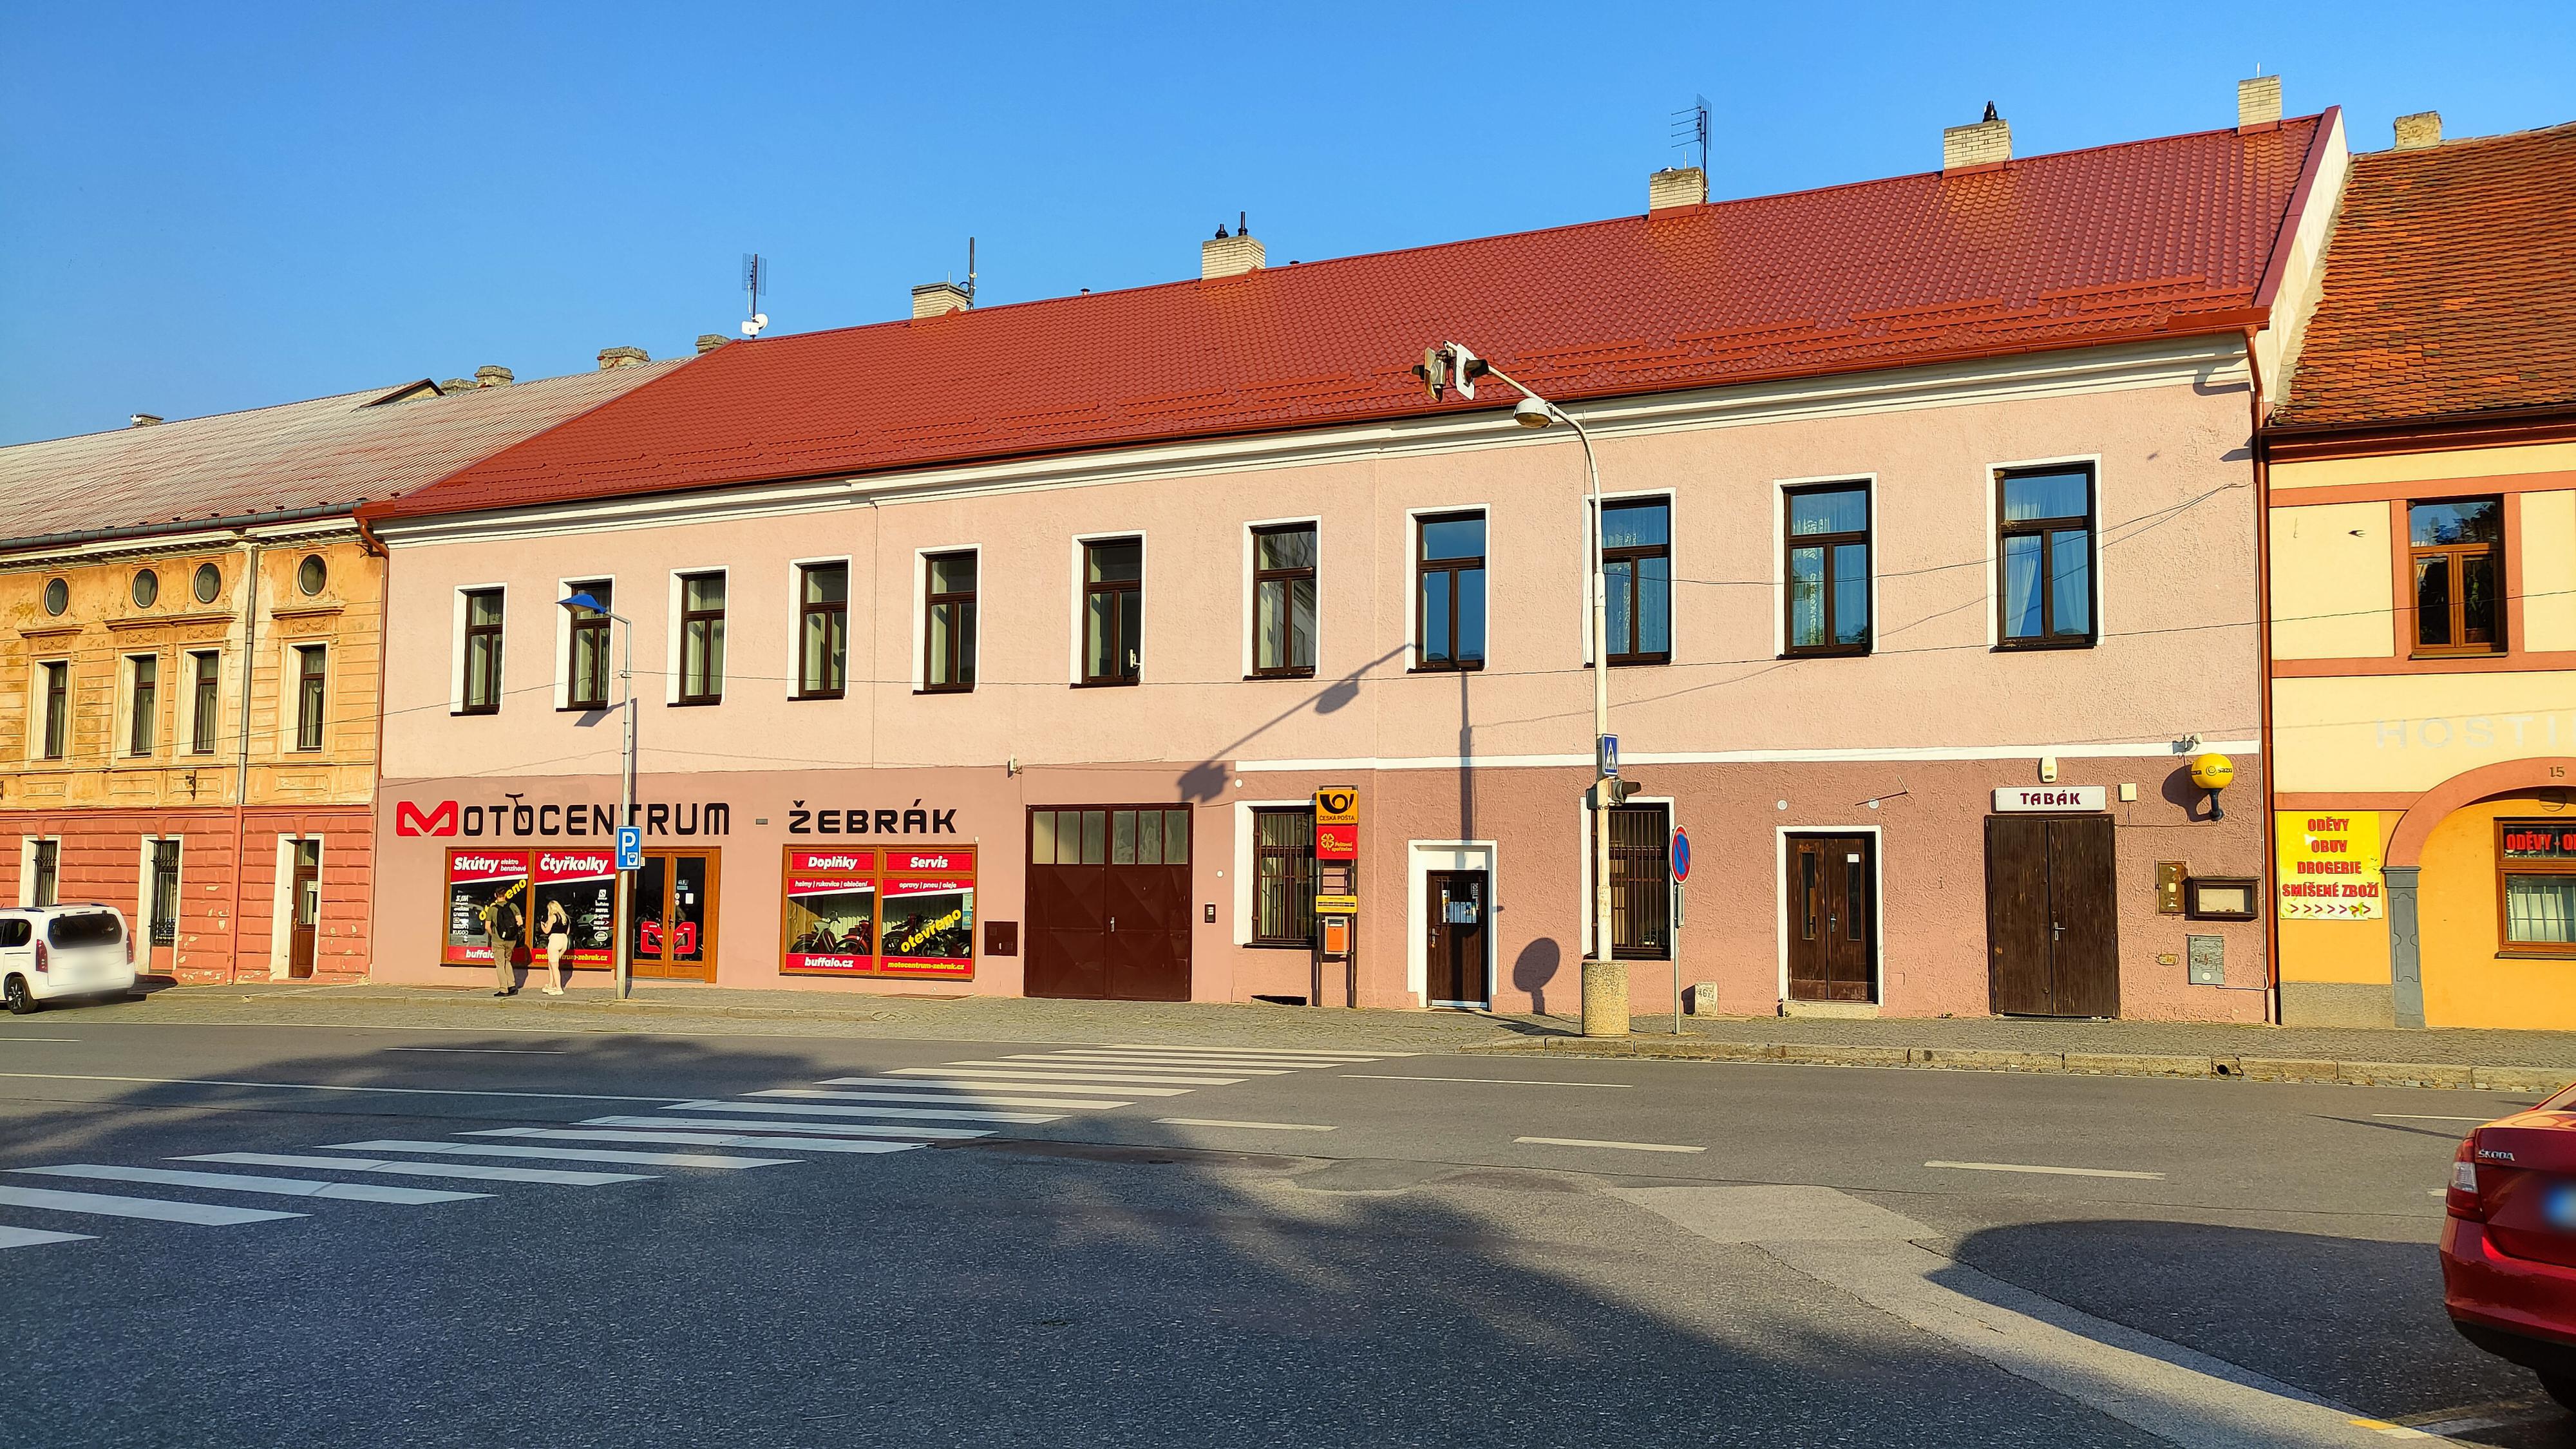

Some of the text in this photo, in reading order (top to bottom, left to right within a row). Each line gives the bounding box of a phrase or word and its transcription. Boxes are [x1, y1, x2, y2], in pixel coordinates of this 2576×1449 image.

[2376, 715, 2576, 748] HOSTI
[2549, 766, 2565, 778] 15
[2020, 790, 2081, 806] TABÁK
[789, 799, 957, 834] ŽEBRÁK
[2308, 817, 2349, 831] ODĚVY
[622, 831, 636, 856] P
[2311, 840, 2348, 853] OBUV
[2506, 831, 2552, 850] ODĚVY
[454, 857, 500, 873] Skútry
[540, 853, 609, 874] Čtyřkolky
[808, 856, 858, 870] Doplňky
[910, 855, 948, 868] Servis
[2297, 861, 2362, 874] DROGERIE
[2282, 882, 2380, 897] SMÍŠENÉ ZBOŽÍ
[901, 909, 961, 952] otevřeno
[804, 957, 854, 967] buffalo.cz
[2478, 1149, 2515, 1161] ŠKODA
